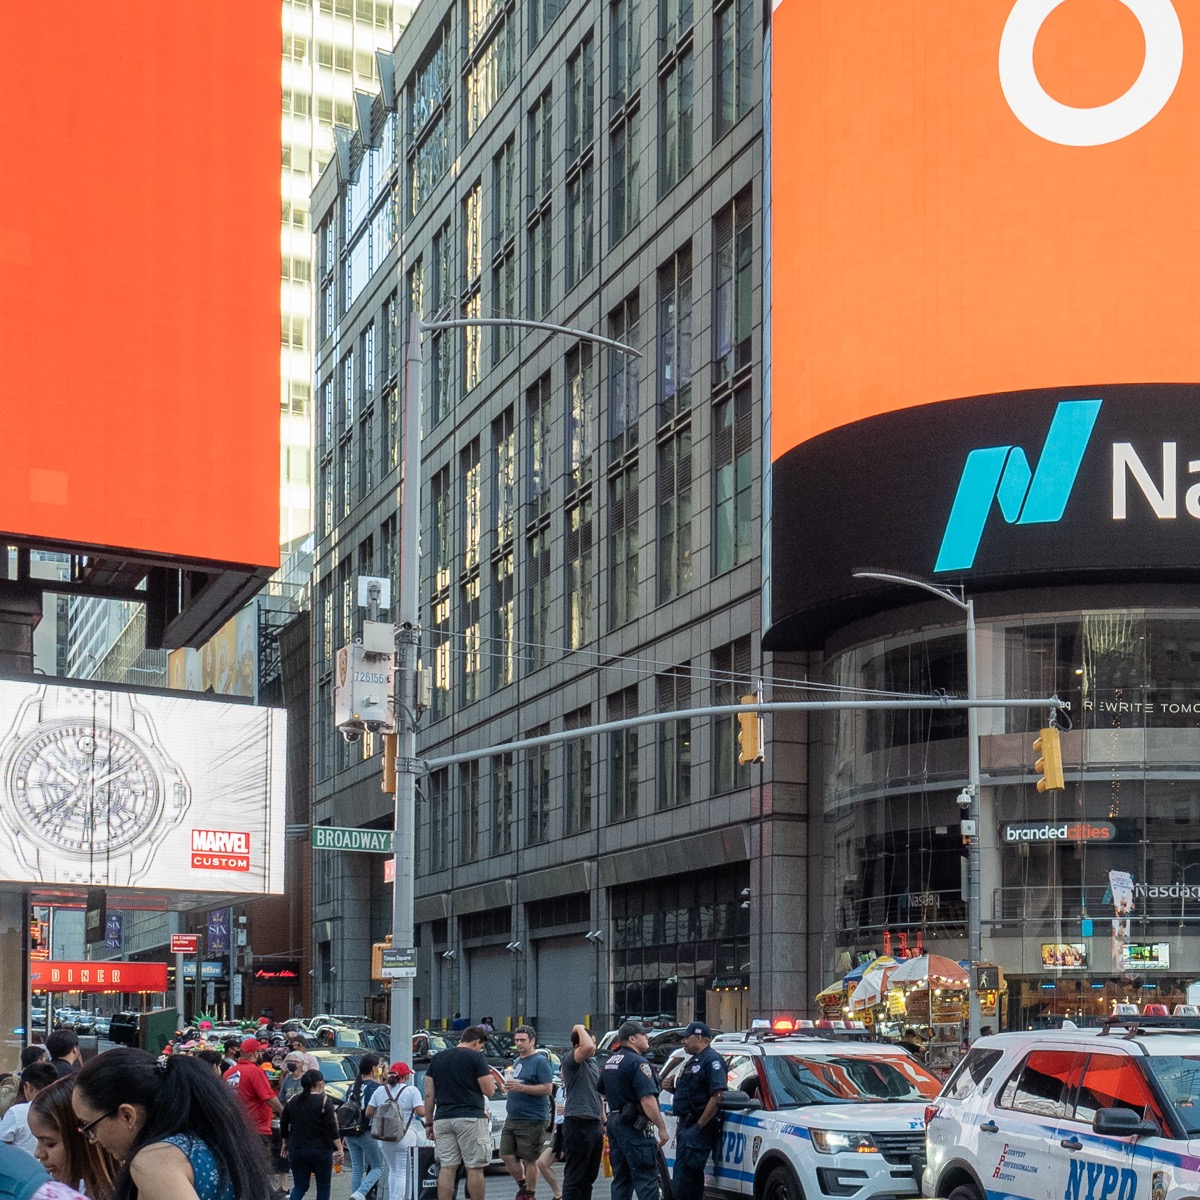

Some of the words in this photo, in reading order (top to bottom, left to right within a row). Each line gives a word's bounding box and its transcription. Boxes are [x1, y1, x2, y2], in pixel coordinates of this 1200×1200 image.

[355, 671, 384, 684] 726156
[1084, 701, 1154, 713] REWRITE
[317, 830, 387, 849] BROADWAY
[1006, 823, 1110, 841] brandedcities
[192, 831, 248, 853] MARVEL
[193, 857, 247, 868] CUSTOM
[908, 893, 940, 908] Nasdaq
[208, 924, 226, 934] SIX
[52, 969, 120, 982] DINER
[720, 1131, 746, 1164] YPD
[1065, 1158, 1138, 1200] NYPD
